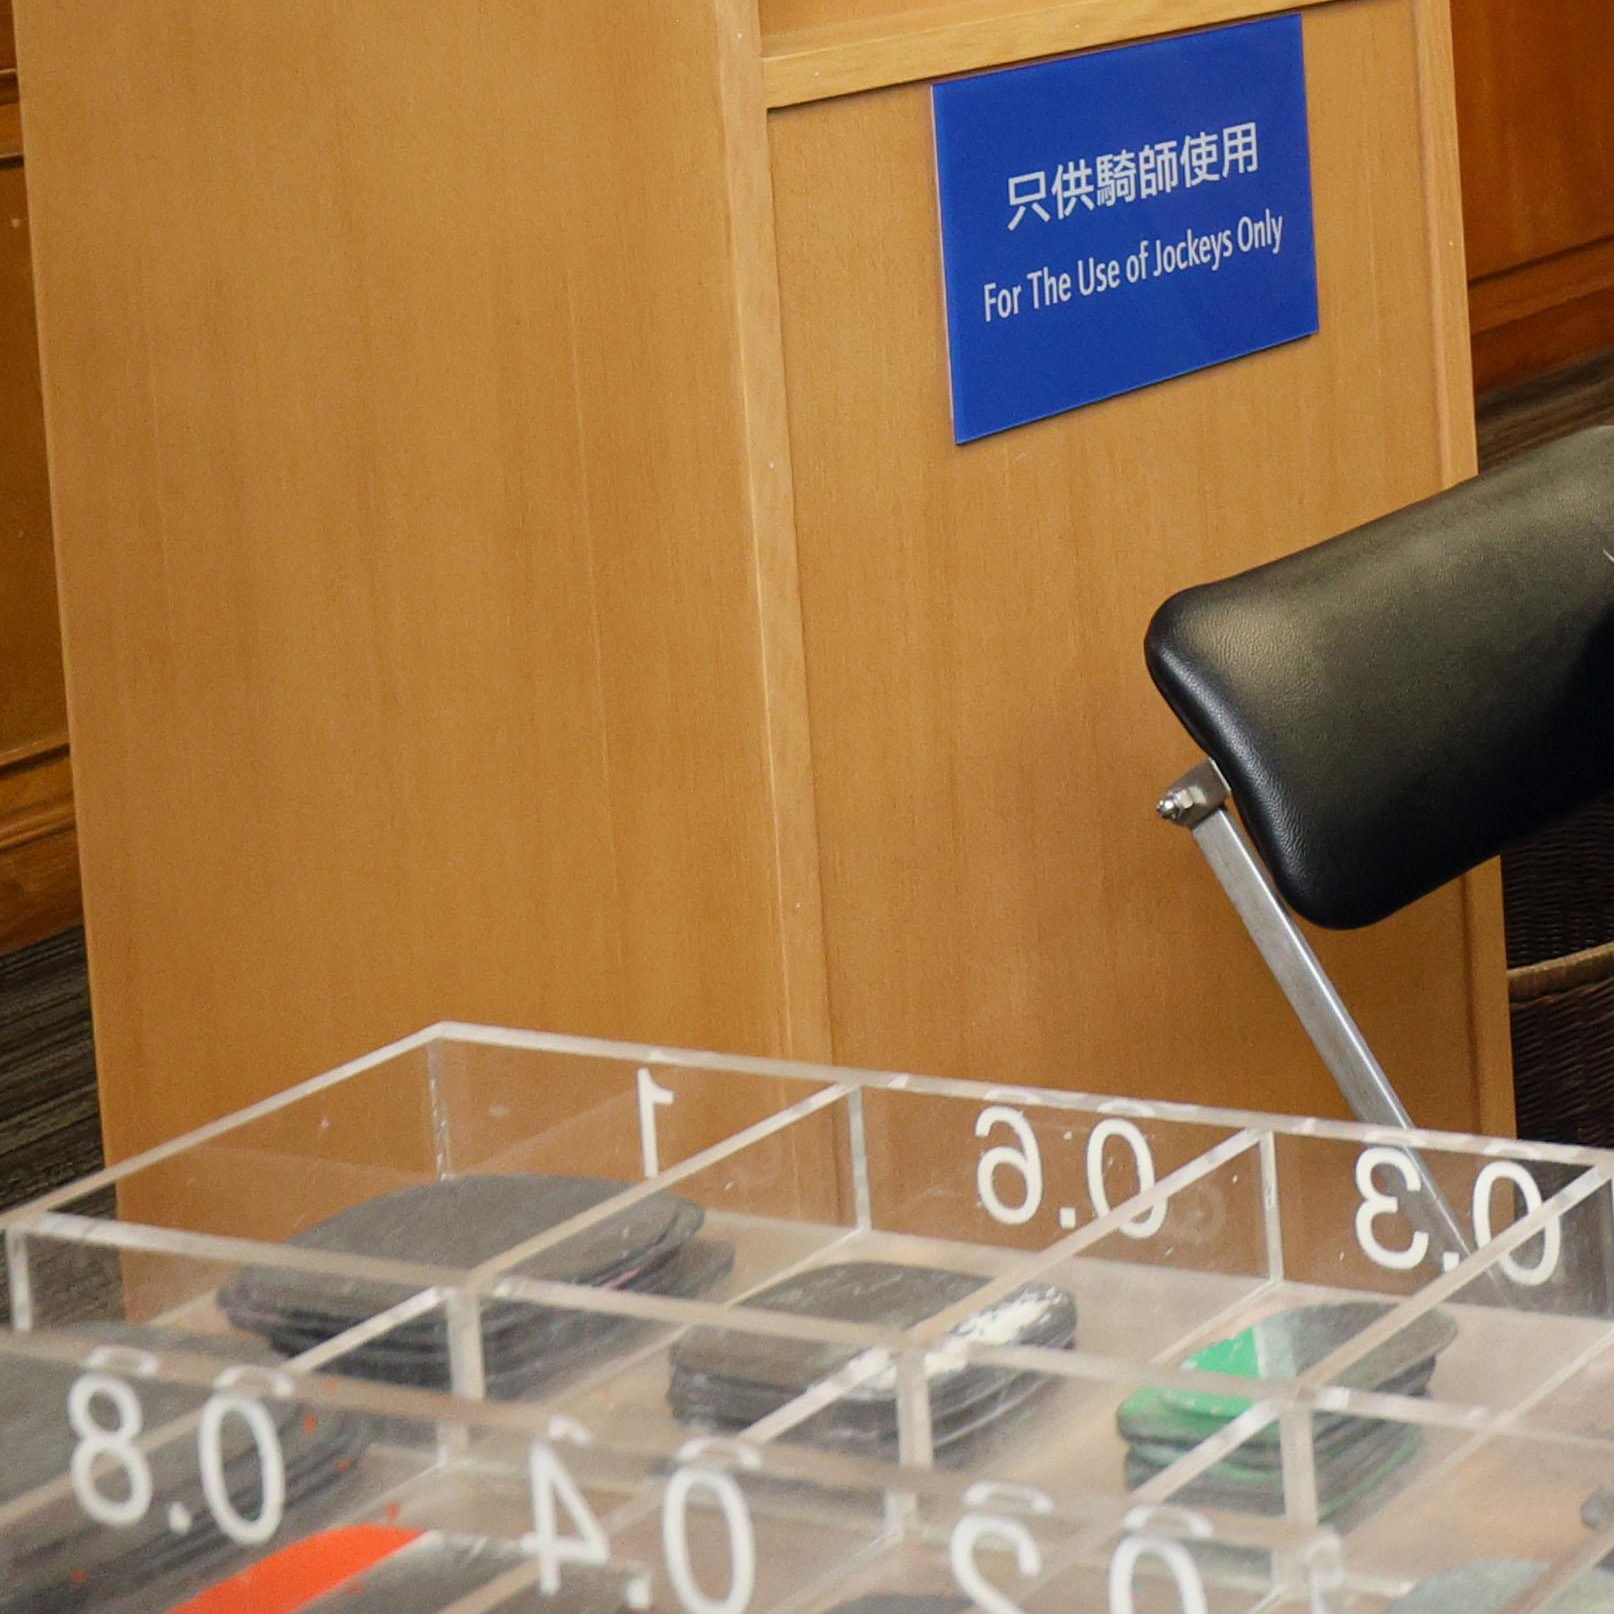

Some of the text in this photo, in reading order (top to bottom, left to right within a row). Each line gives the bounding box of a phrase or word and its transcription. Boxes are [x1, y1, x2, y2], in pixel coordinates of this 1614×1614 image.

[1006, 122, 1259, 231] 只供騎師使用
[983, 208, 1284, 322] For The Use of Jockeys Only
